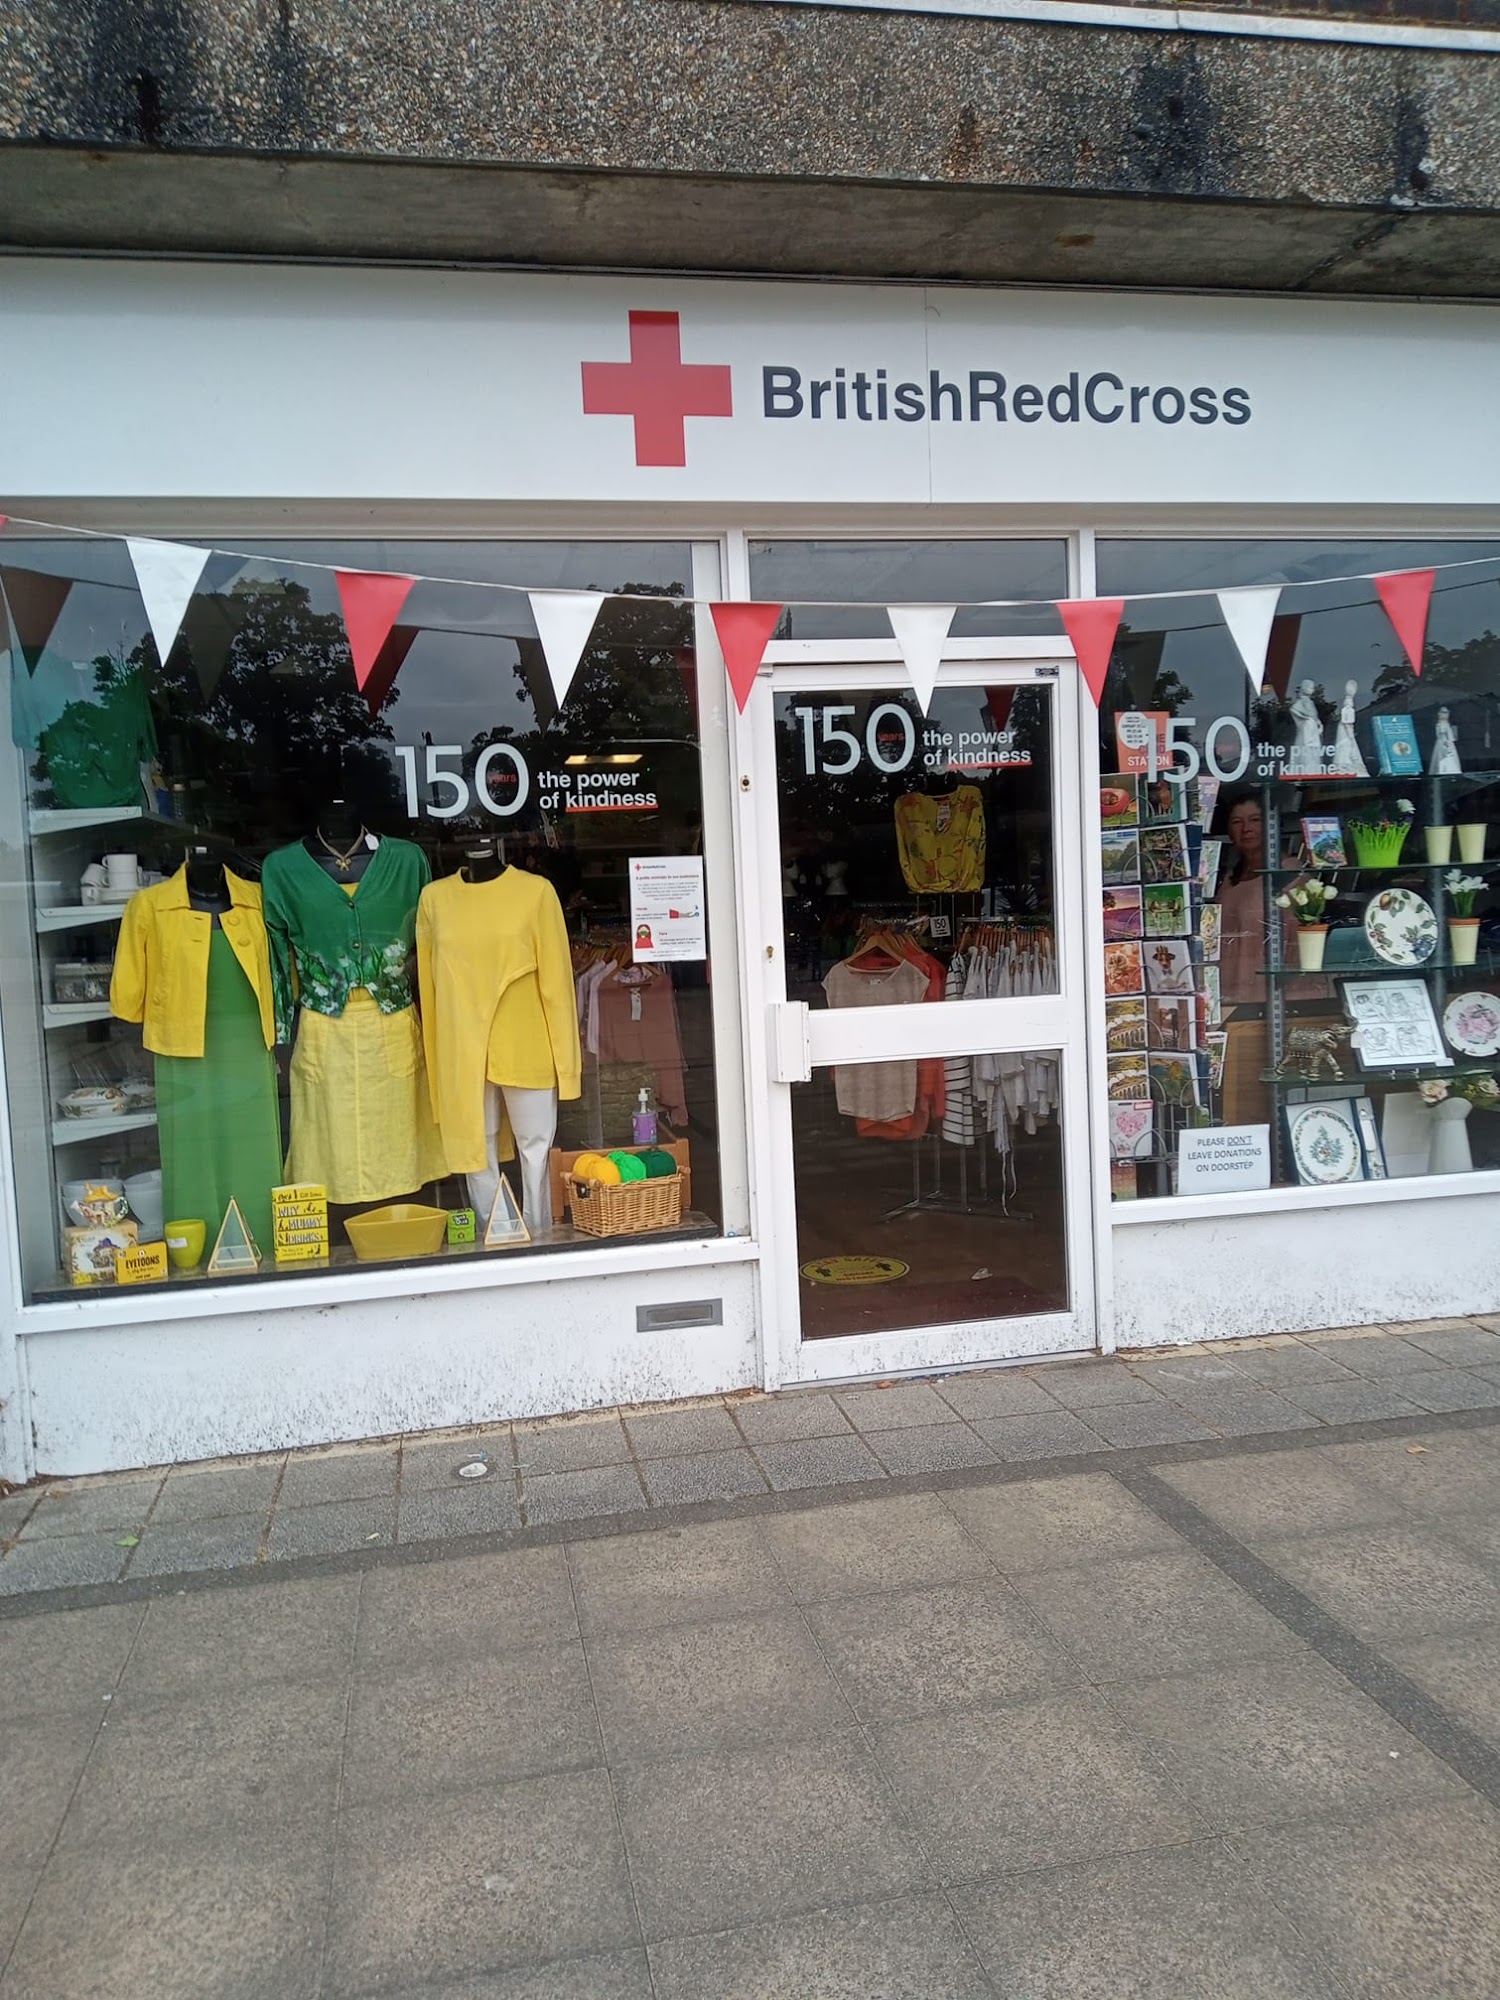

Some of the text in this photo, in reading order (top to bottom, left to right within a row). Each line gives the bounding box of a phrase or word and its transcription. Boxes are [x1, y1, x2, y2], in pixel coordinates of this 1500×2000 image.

[762, 365, 1252, 425] BritishRedCross
[793, 703, 916, 775] 150
[922, 730, 1017, 748] the power
[923, 747, 1032, 766] of kindness
[1140, 716, 1251, 783] 150
[1257, 742, 1286, 758] the
[1127, 755, 1170, 767] STAON
[1257, 761, 1276, 777] of
[393, 743, 530, 818] 150
[537, 771, 640, 792] the power
[539, 790, 658, 810] of kindness
[1197, 1135, 1253, 1146] PLEASE DON'T
[1188, 1148, 1262, 1160] LEAVE DONATIONS
[1196, 1161, 1254, 1172] ON DOORSTEP
[278, 1205, 299, 1217] WHY
[288, 1216, 322, 1230] MUMMY
[287, 1231, 320, 1245] DRINKS
[126, 1255, 160, 1269] EYETOONS
